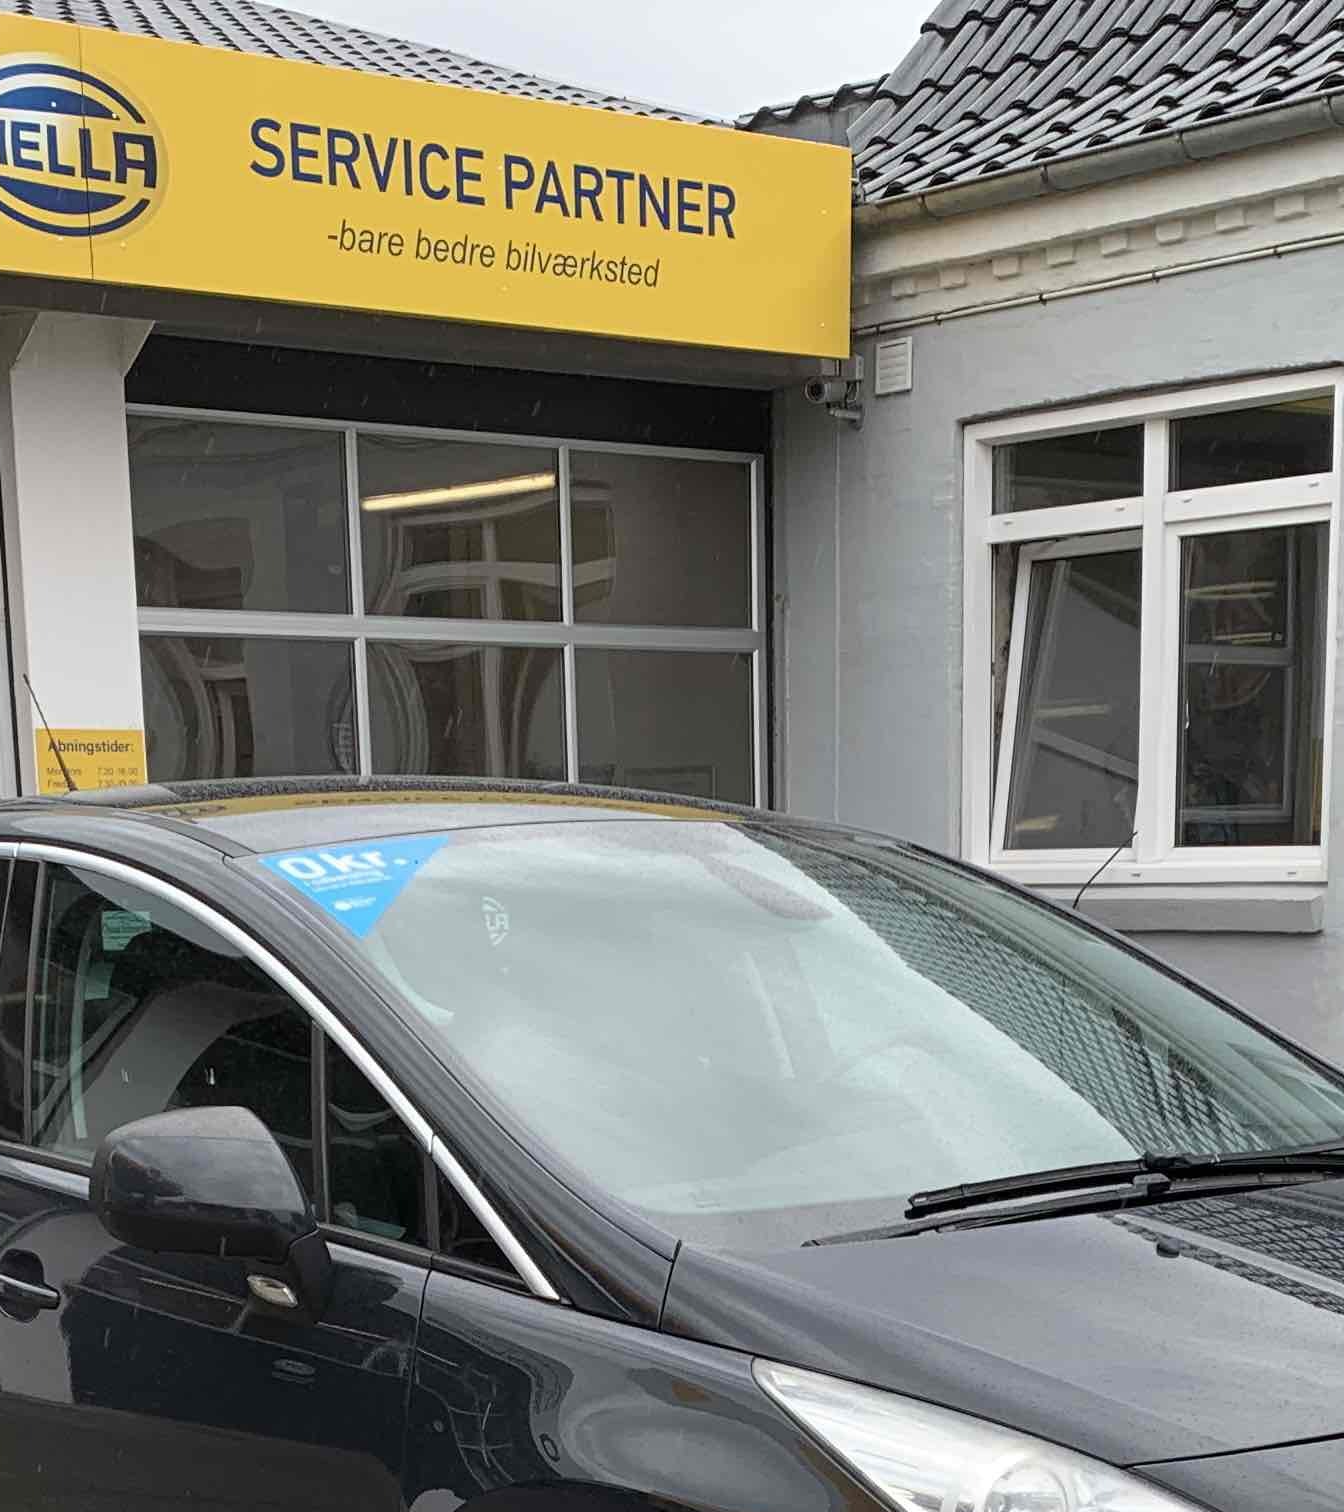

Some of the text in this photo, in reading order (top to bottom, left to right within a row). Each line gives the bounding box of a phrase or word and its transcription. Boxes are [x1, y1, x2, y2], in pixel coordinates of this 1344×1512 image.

[250, 118, 736, 239] SERVICE PARTNER
[416, 228, 496, 268] bedre
[506, 240, 661, 288] bilværksted
